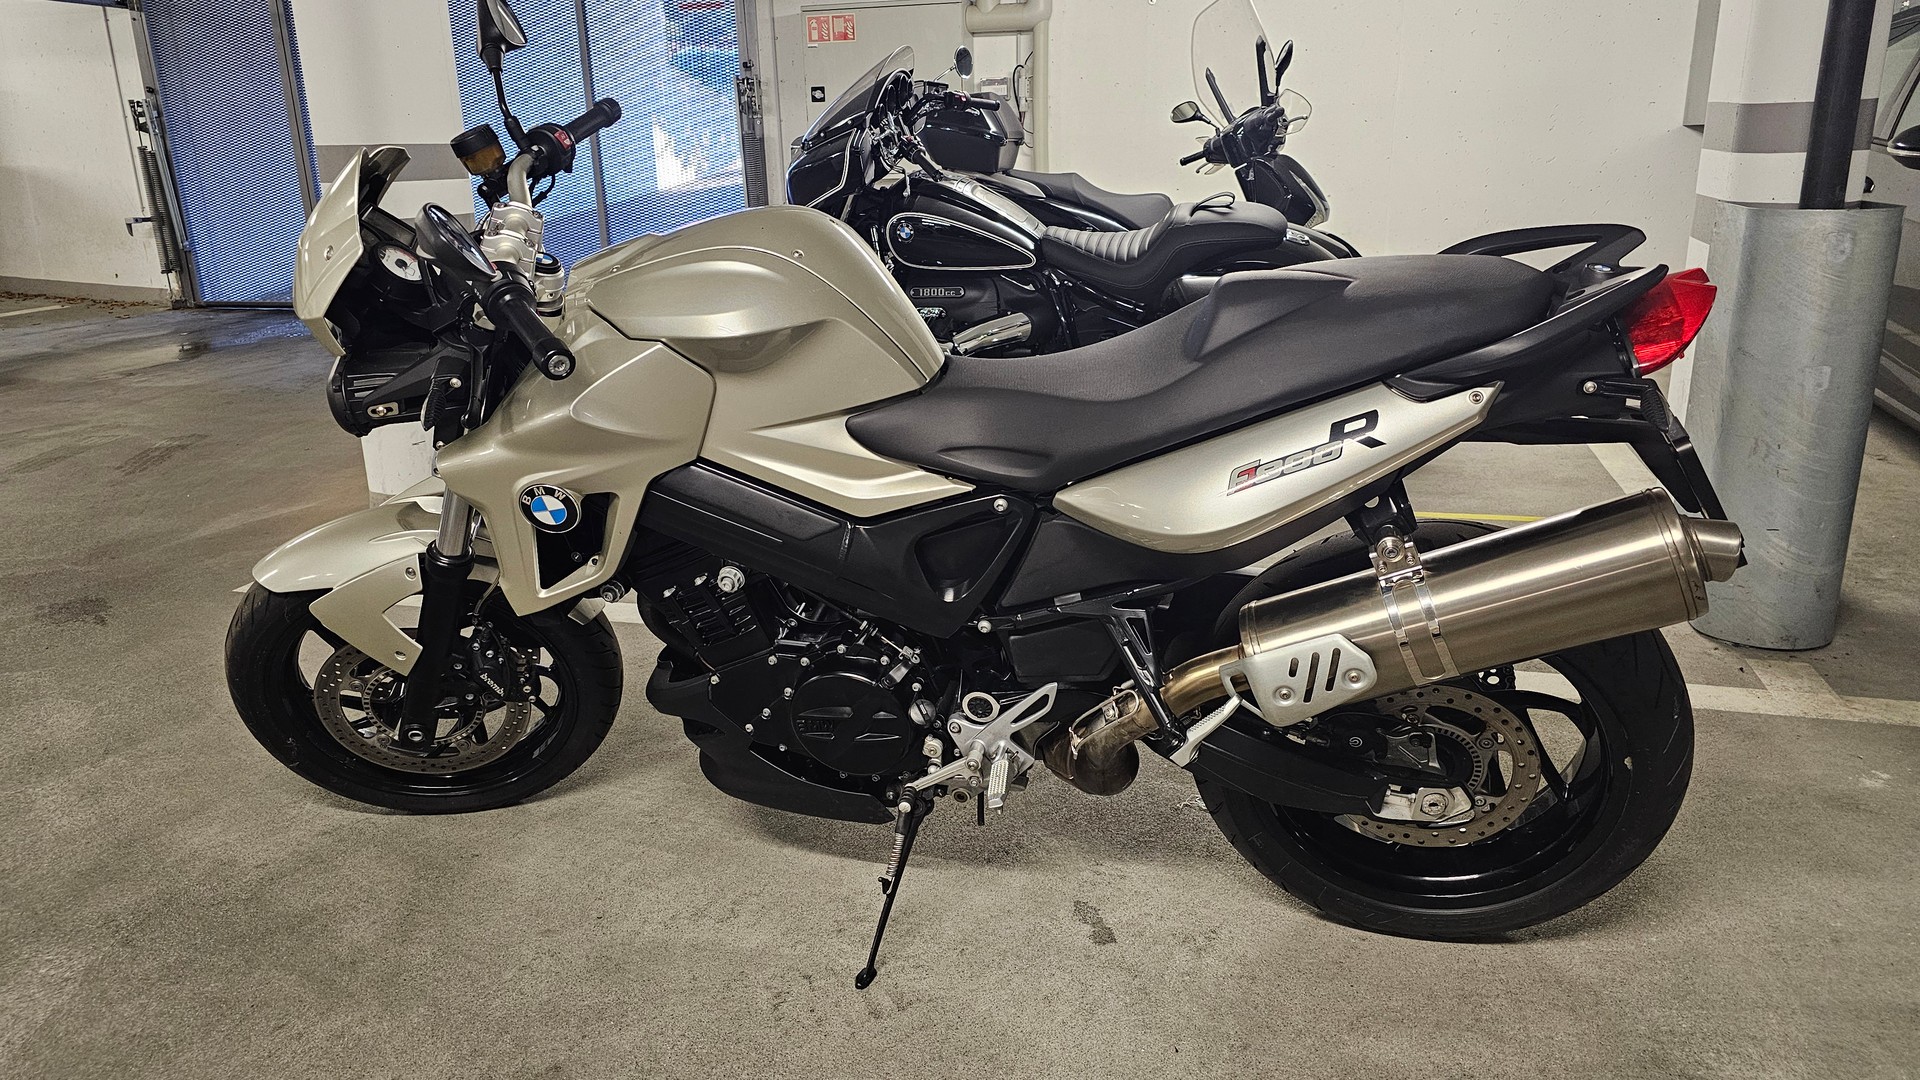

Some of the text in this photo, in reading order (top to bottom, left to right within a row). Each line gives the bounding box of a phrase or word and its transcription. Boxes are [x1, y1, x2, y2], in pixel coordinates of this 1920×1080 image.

[919, 288, 956, 297] 1800cc
[521, 486, 567, 506] BMW
[479, 672, 505, 698] bremb
